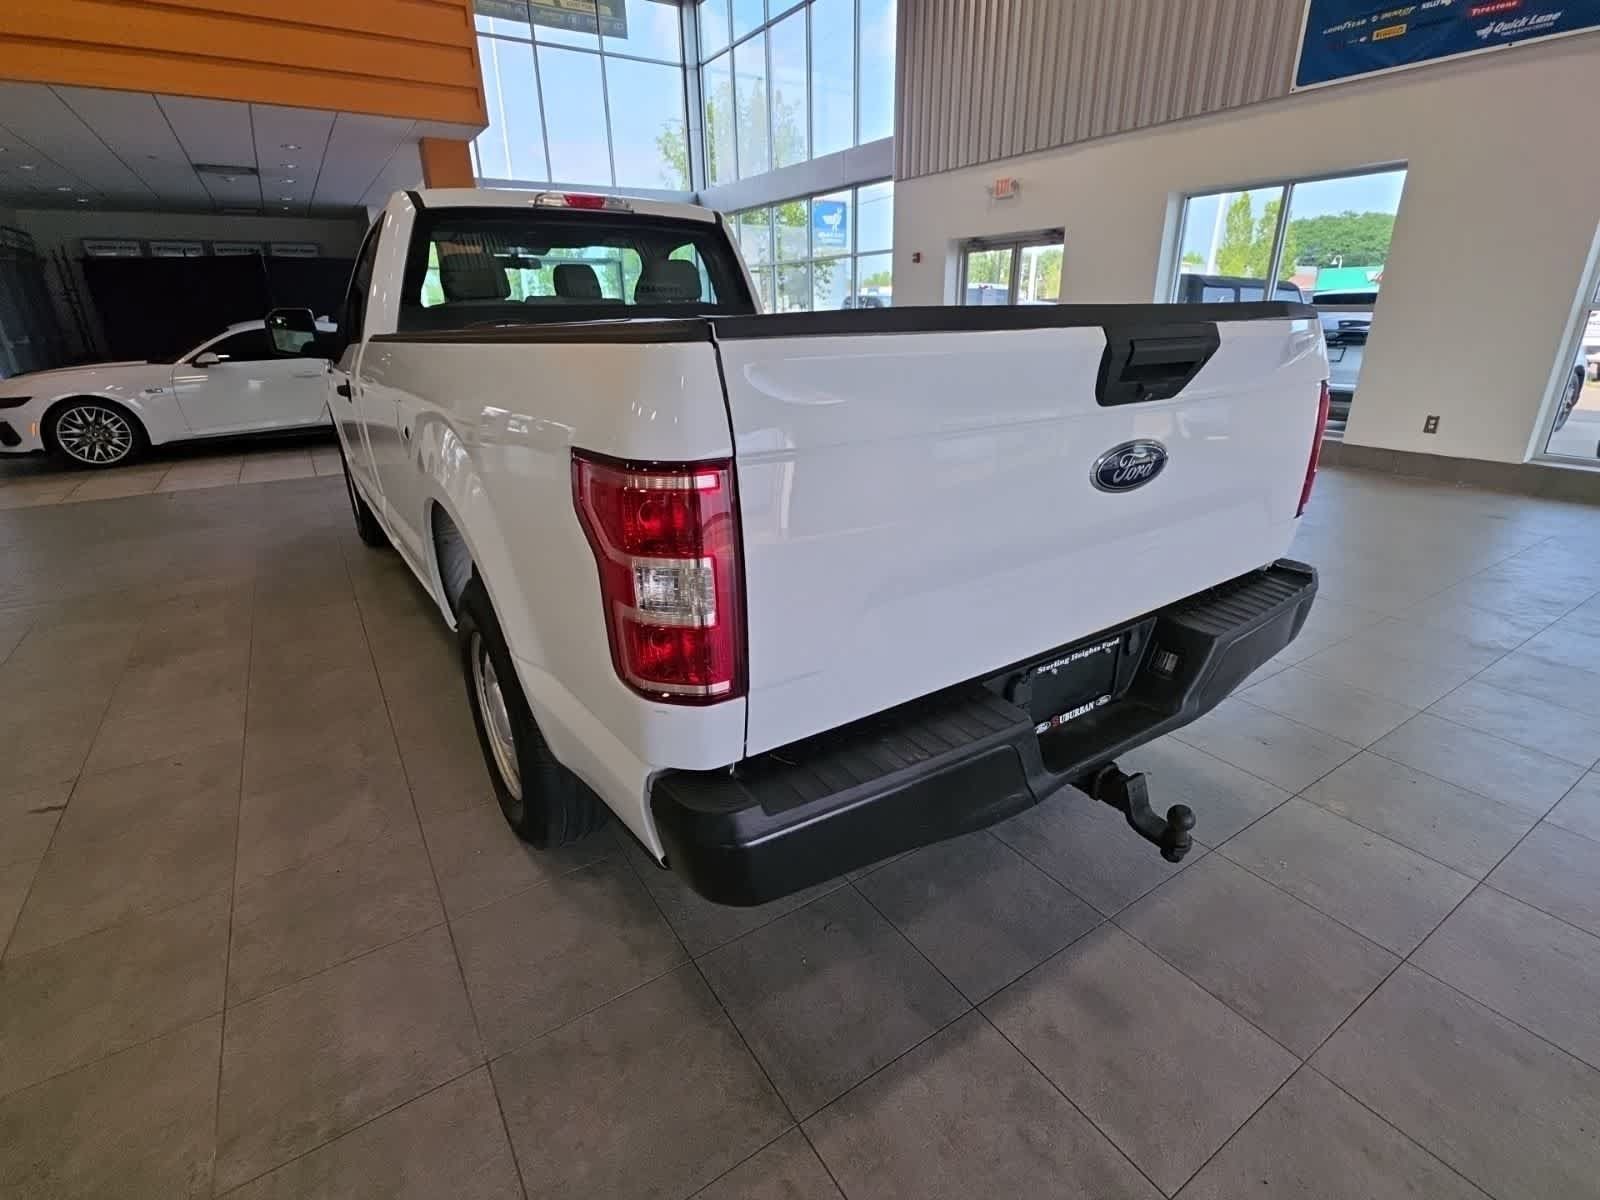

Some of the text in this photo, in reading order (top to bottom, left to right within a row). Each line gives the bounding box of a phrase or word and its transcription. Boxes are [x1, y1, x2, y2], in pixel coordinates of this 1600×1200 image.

[1493, 16, 1528, 33] Quick
[1113, 453, 1154, 482] Ford
[1037, 637, 1119, 674] Sterling Heights Ford
[1051, 701, 1095, 727] SUBURBAN
